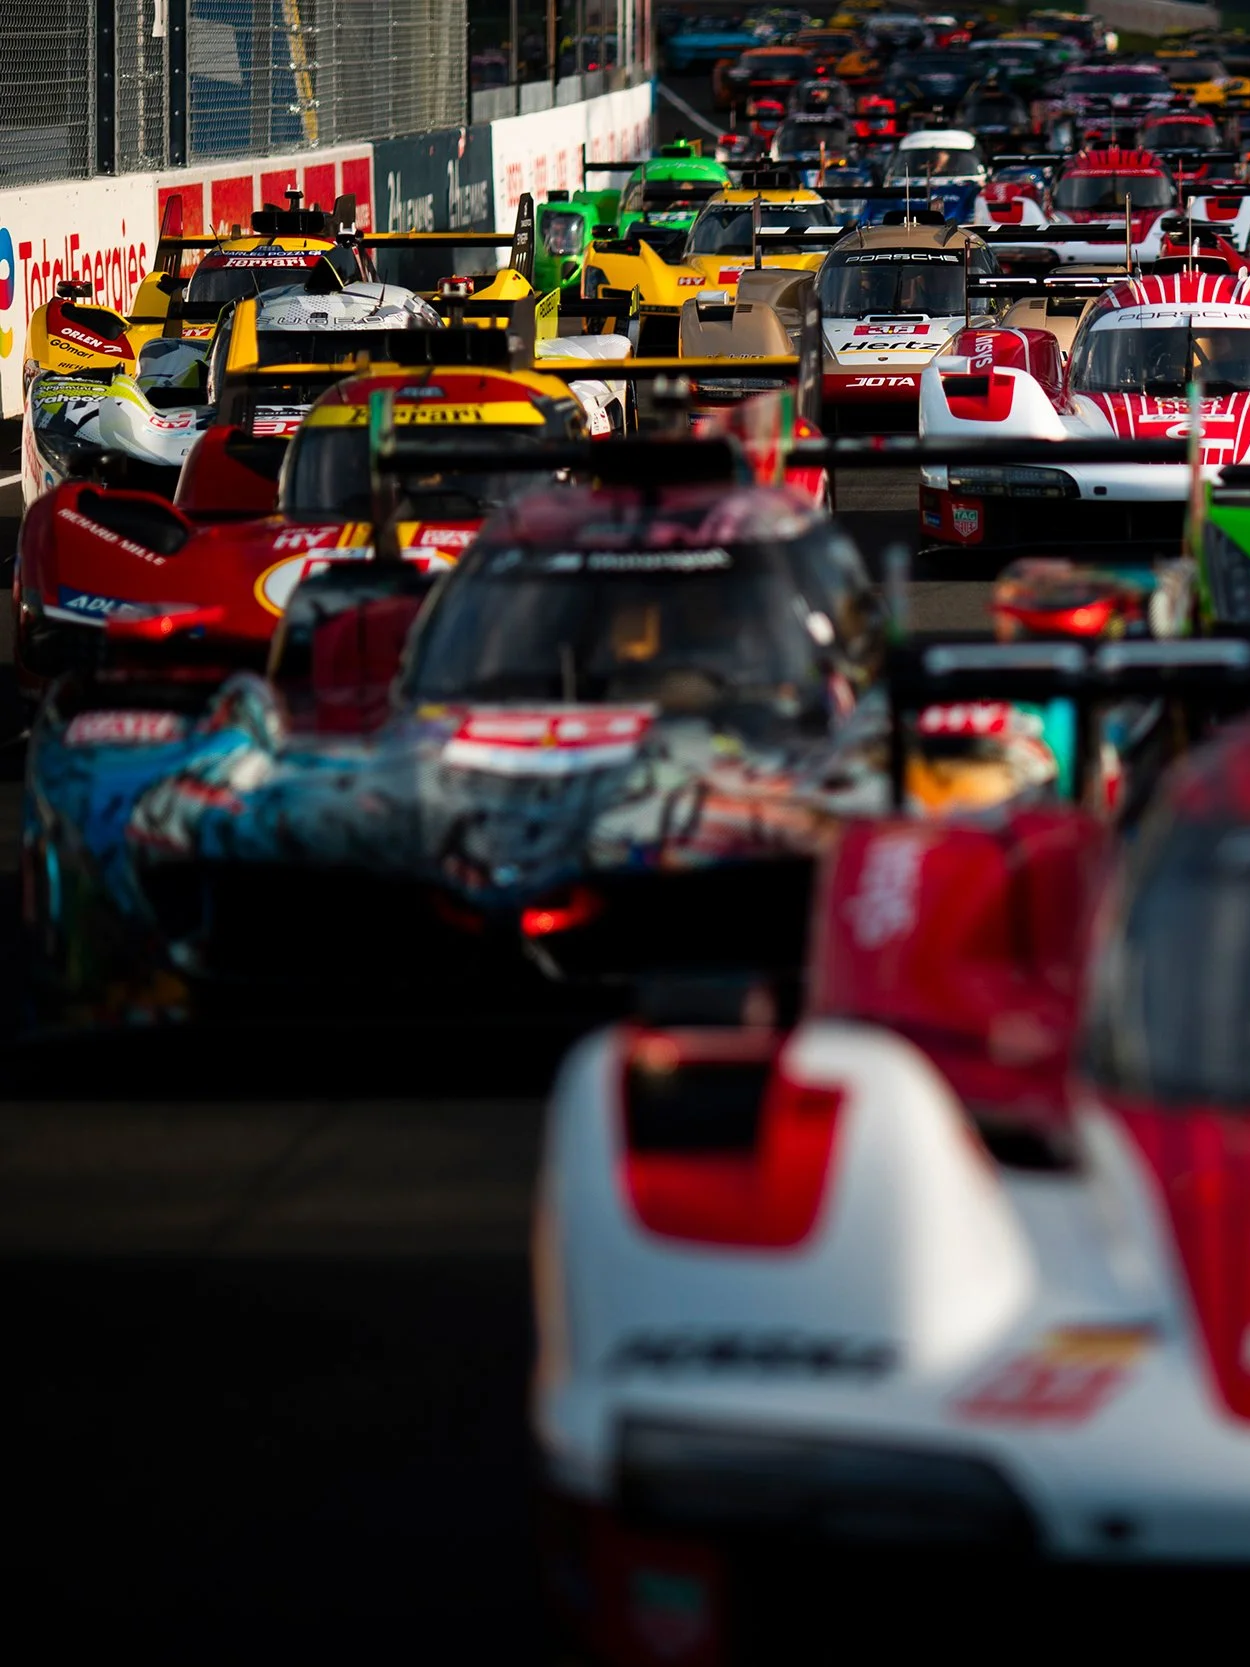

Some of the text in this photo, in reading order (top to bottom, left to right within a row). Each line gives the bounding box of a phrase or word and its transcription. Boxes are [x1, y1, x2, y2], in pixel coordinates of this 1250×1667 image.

[223, 257, 307, 268] Ferrari
[845, 253, 960, 264] PORSCHE
[19, 219, 147, 321] TotalEnergies
[679, 277, 705, 285] HY
[256, 313, 406, 326] EUGEOT
[867, 325, 915, 334] 38
[60, 327, 104, 348] ORLEN
[50, 338, 95, 359] GOmart
[839, 341, 942, 352] Hertz
[846, 376, 916, 388] JOTA
[33, 394, 106, 409] yahoo!
[350, 403, 485, 424] Frrari
[956, 511, 976, 520] TAG
[56, 508, 166, 567] RICHARD MILLE
[272, 531, 331, 550] HY
